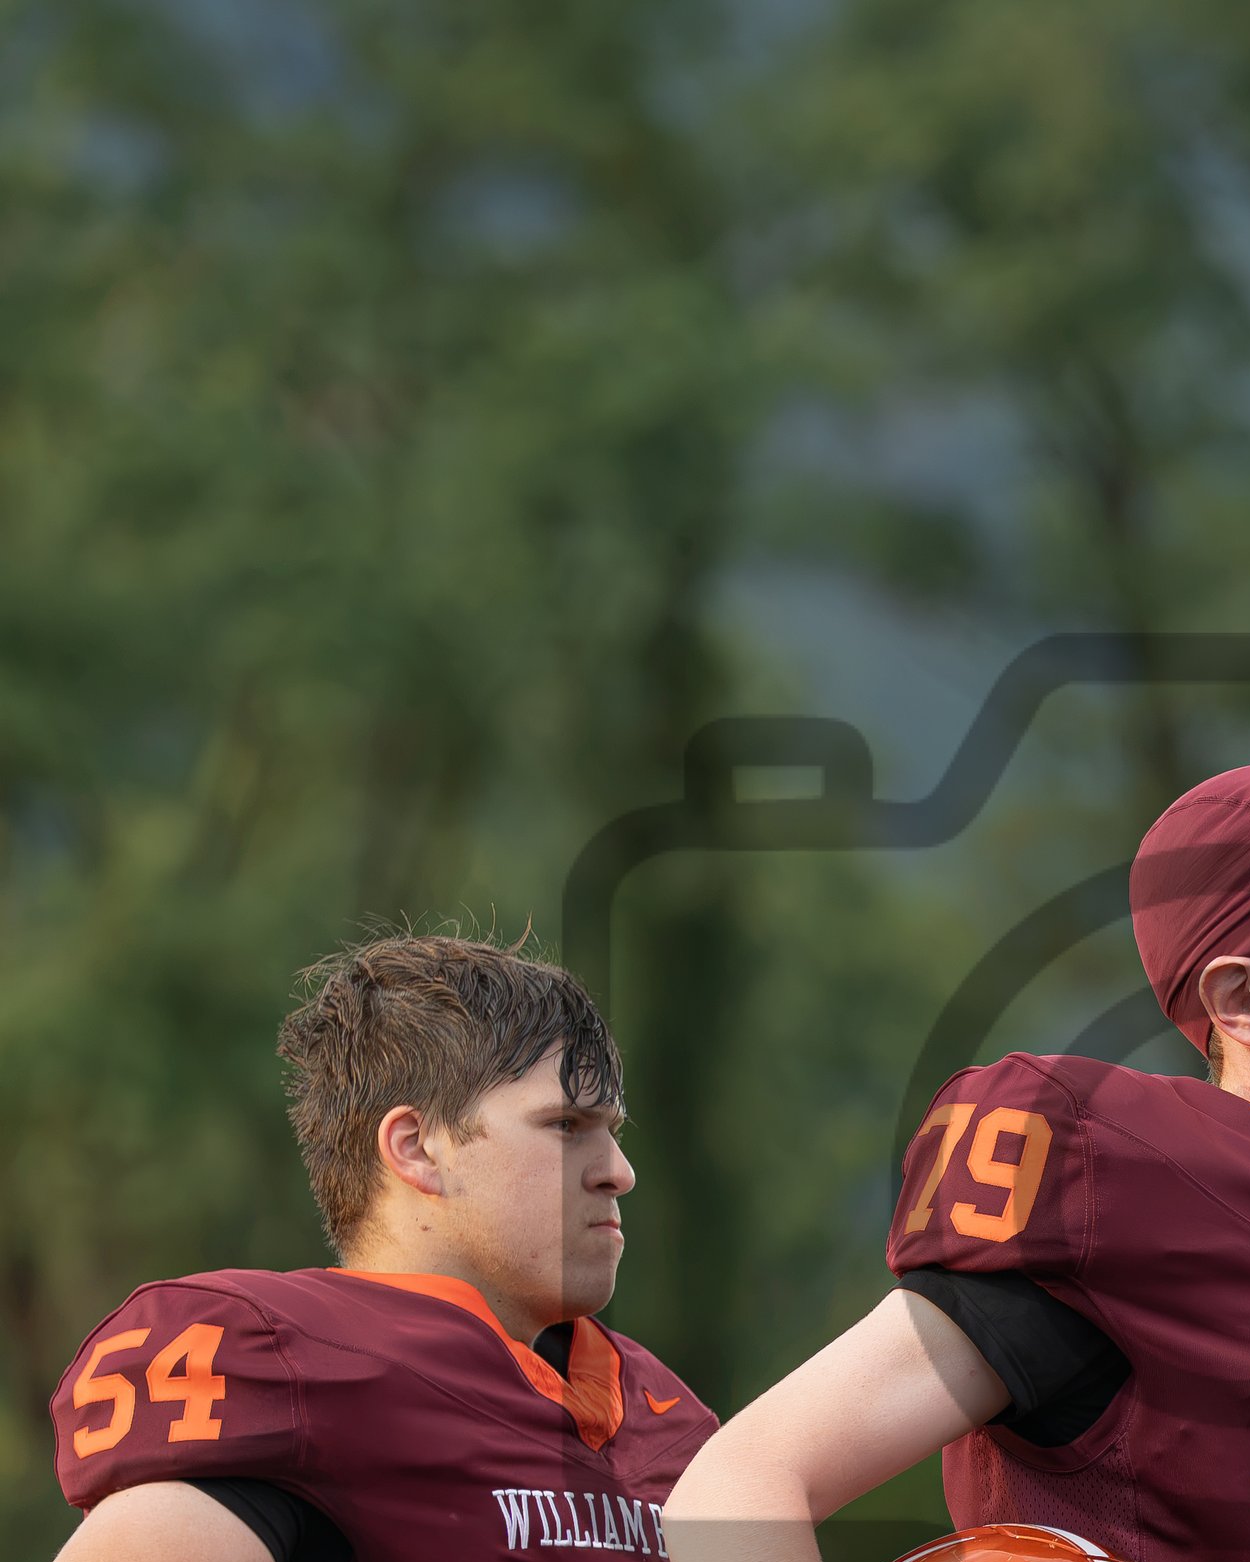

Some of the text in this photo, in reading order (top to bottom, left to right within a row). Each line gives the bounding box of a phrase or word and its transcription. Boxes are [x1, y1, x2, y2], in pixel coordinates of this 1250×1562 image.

[905, 1103, 1052, 1243] 79
[73, 1324, 226, 1459] 54
[492, 1489, 651, 1555] WILLIAM
